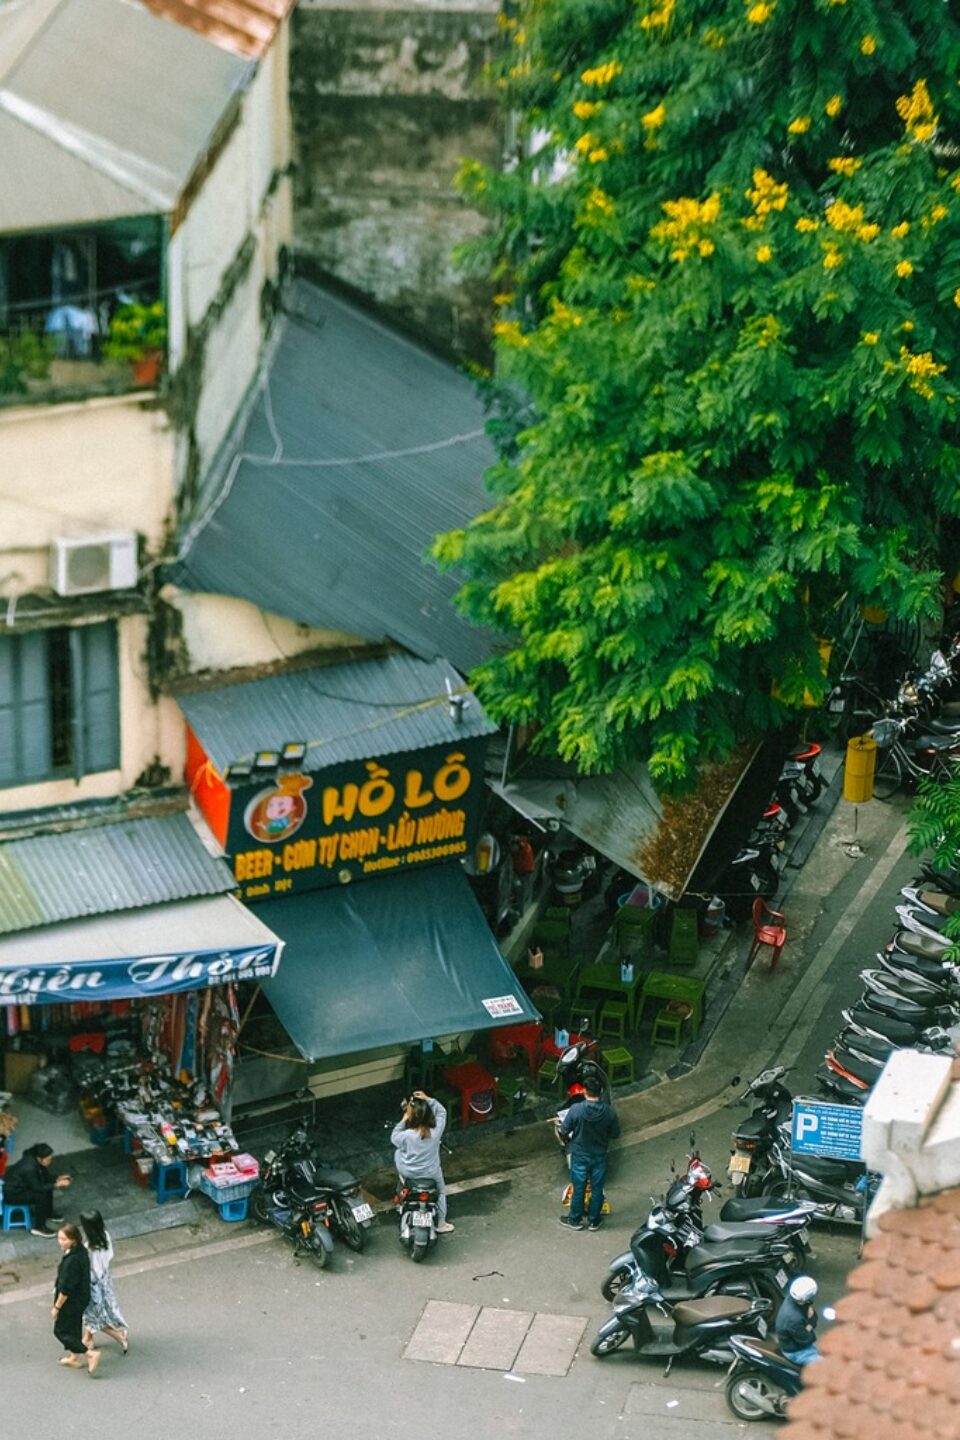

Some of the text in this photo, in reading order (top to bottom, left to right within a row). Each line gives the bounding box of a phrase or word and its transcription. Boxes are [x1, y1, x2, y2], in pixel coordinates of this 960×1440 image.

[323, 752, 471, 825] HỒ LÔ
[235, 849, 273, 881] BEER
[796, 1112, 819, 1141] P
